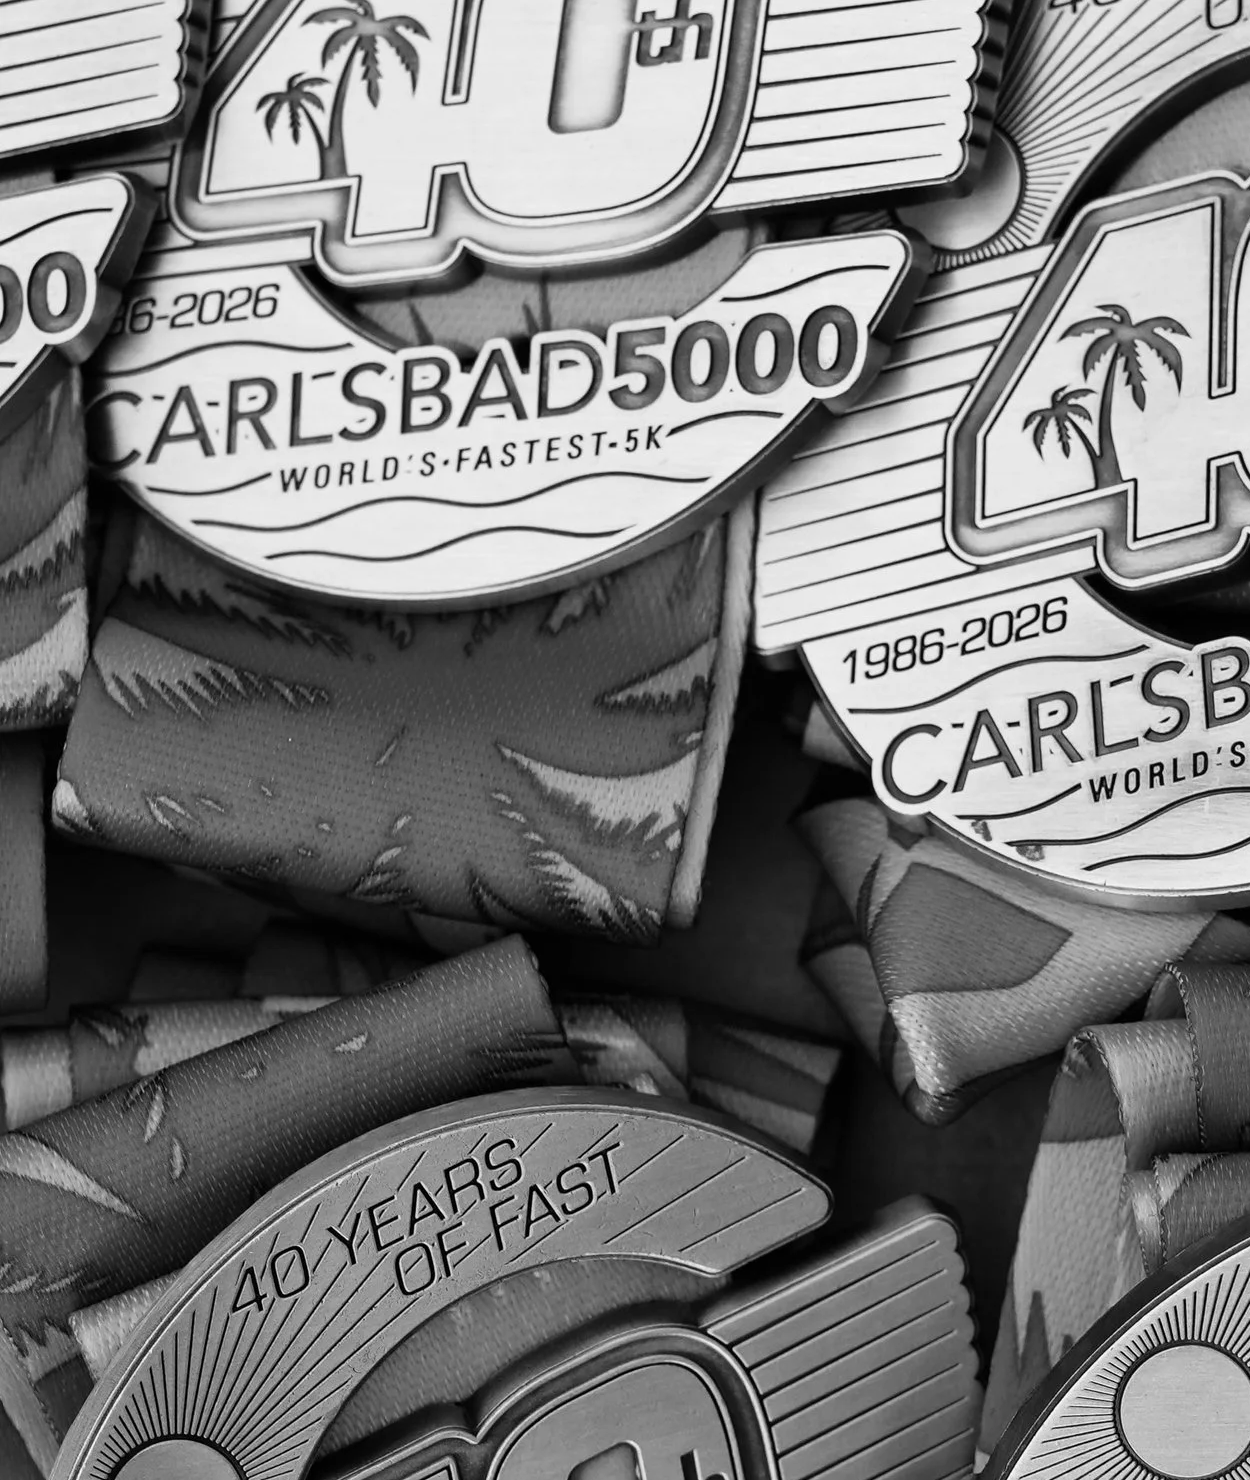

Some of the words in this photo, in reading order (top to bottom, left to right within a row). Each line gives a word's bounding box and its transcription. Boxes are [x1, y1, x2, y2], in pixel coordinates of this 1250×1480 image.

[841, 596, 1068, 684] 1986-2026
[230, 1243, 311, 1316] 40
[330, 1136, 523, 1270] YEARS
[394, 1222, 474, 1298] OF
[494, 1140, 625, 1255] FAST
